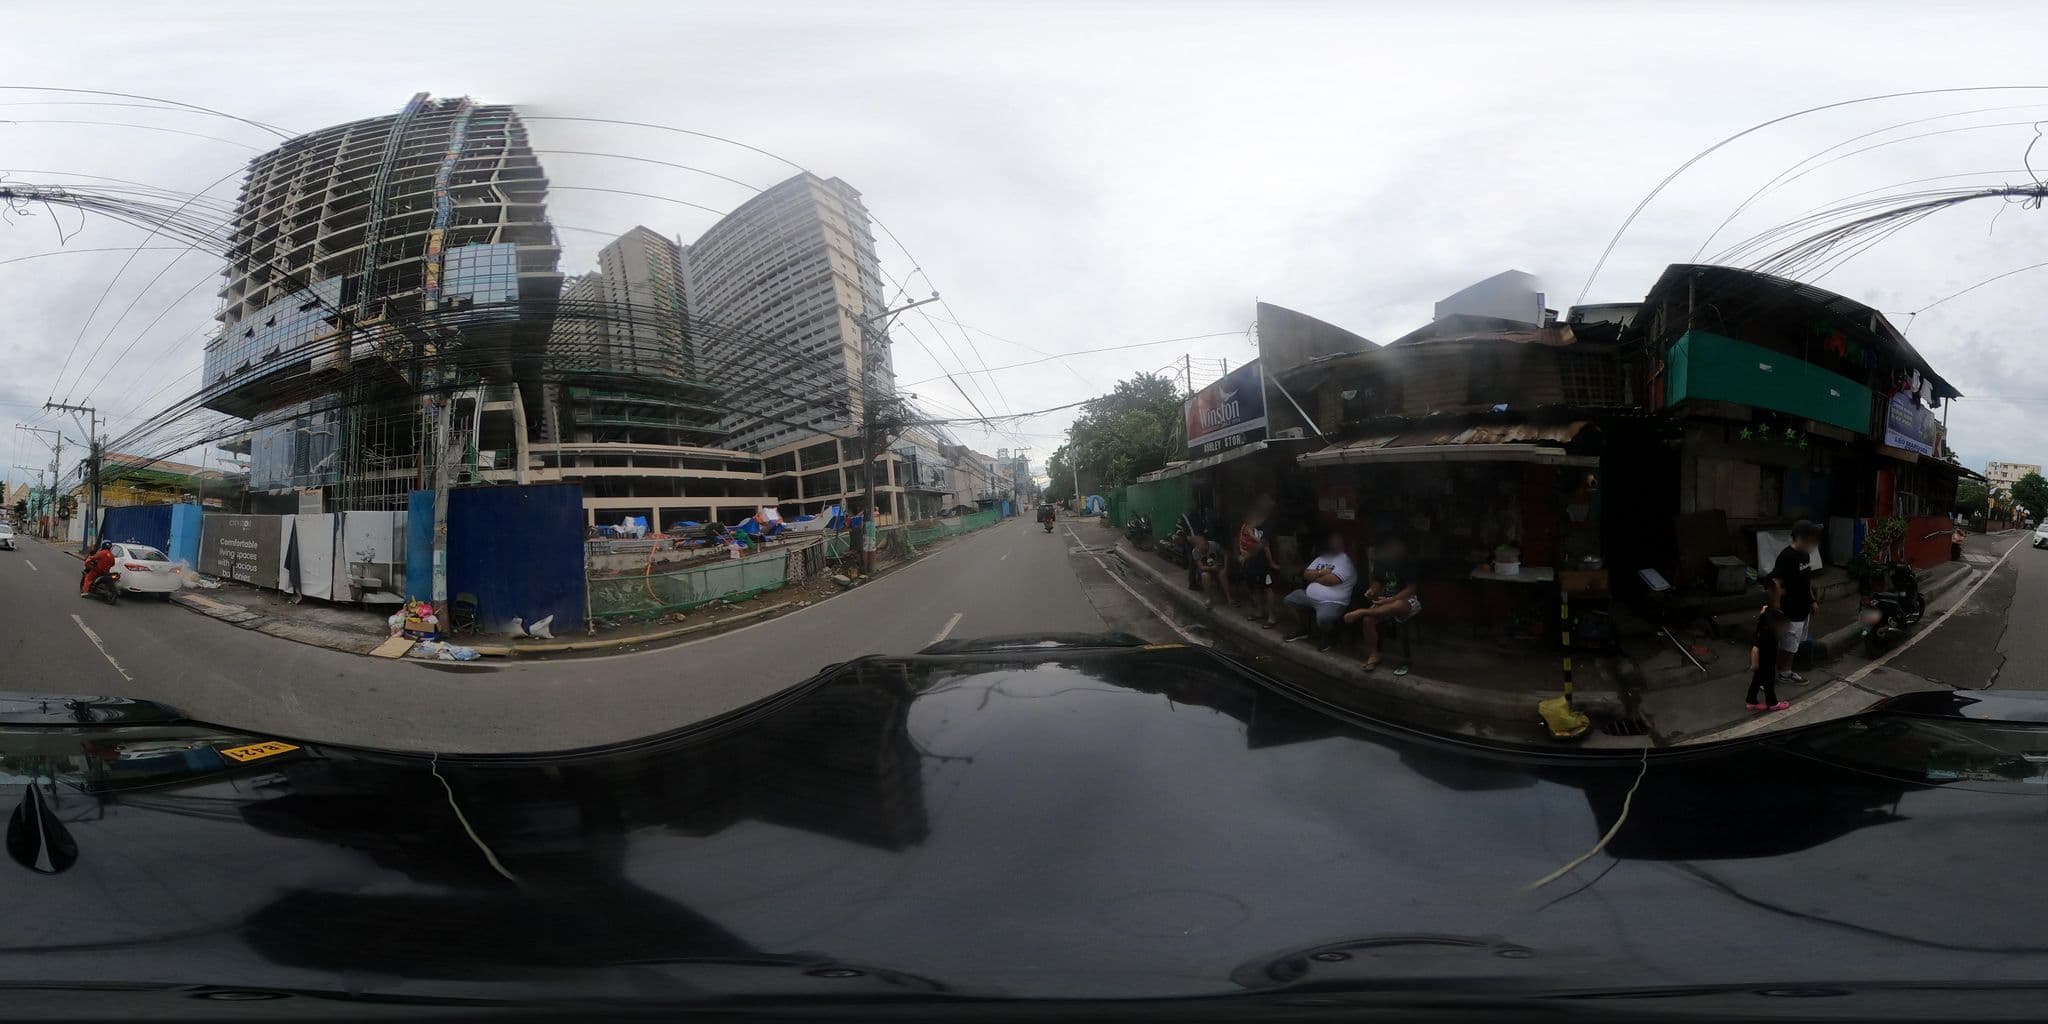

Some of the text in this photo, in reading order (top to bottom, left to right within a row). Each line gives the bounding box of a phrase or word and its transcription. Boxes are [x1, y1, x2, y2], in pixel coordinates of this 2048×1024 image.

[1199, 400, 1240, 430] Winston
[220, 538, 258, 549] Comfortable
[219, 548, 235, 559] living
[217, 558, 230, 567] with
